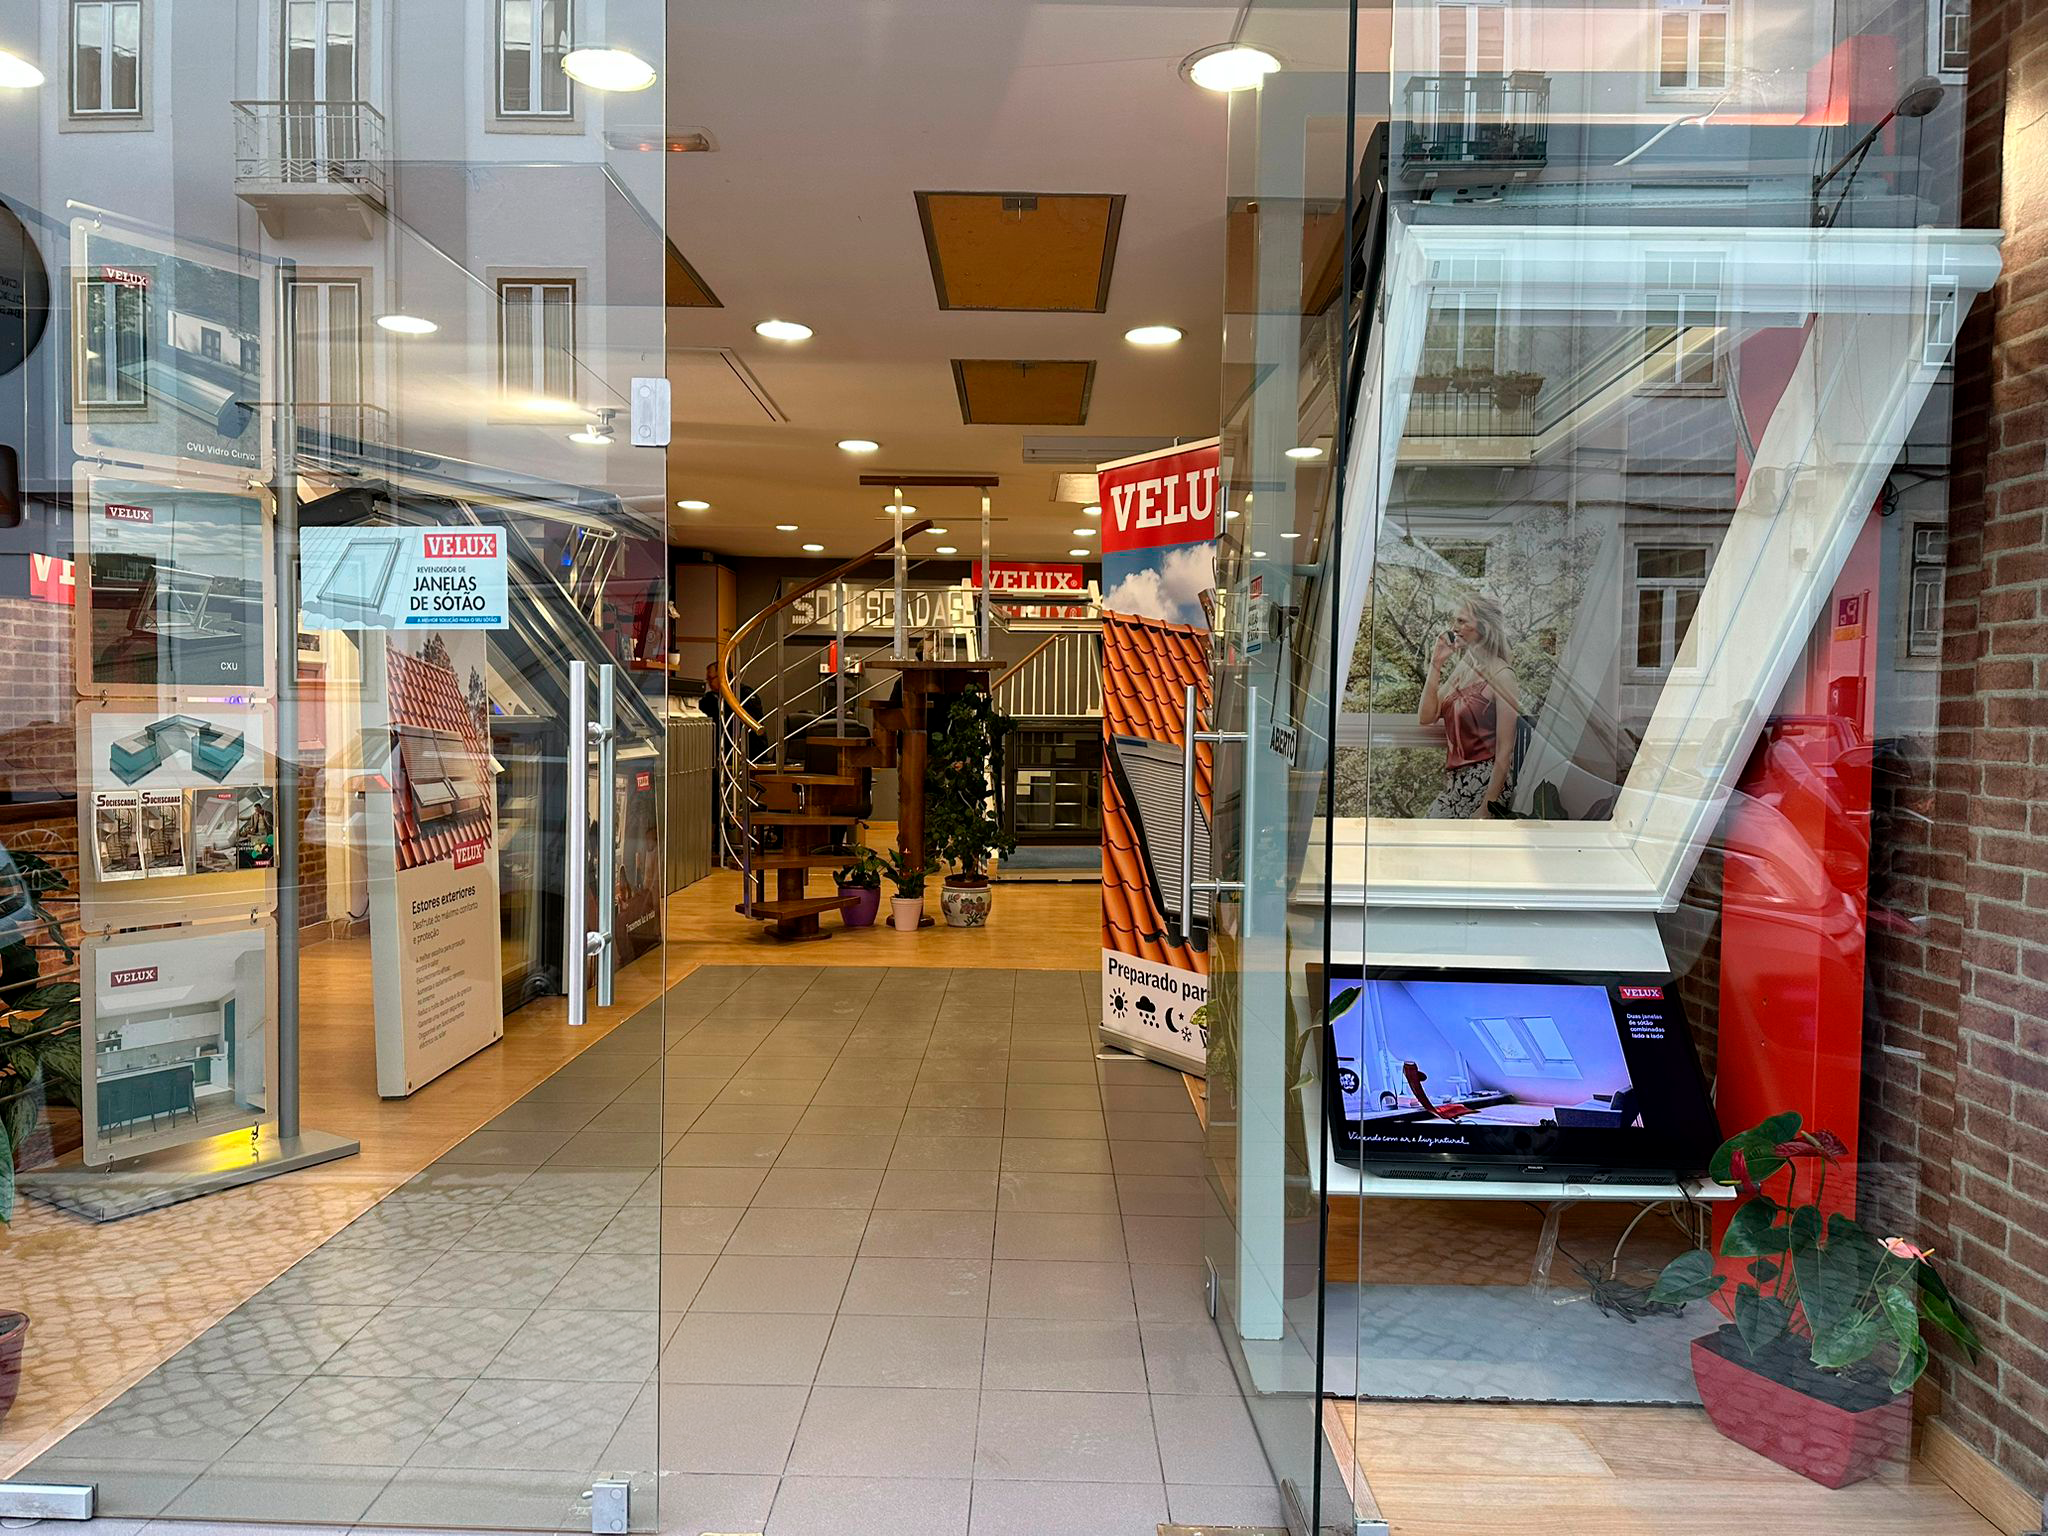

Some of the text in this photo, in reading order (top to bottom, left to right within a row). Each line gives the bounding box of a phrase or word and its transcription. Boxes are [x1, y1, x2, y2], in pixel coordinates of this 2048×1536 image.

[106, 267, 148, 286] VELUX
[187, 442, 205, 453] CVU
[207, 445, 229, 457] Vidro
[1110, 467, 1220, 532] VELU
[109, 506, 150, 521] VELUX
[427, 536, 493, 556] VELUX
[413, 577, 477, 592] JANELAS
[410, 592, 486, 611] DE SÓTÃO
[220, 661, 238, 671] CXU
[1270, 725, 1296, 761] ABERTO
[456, 845, 483, 864] VELUX
[412, 885, 476, 915] Estores exteriores
[114, 968, 155, 984] VELUX
[1108, 957, 1178, 995] Preparado
[1623, 988, 1660, 997] VELUX
